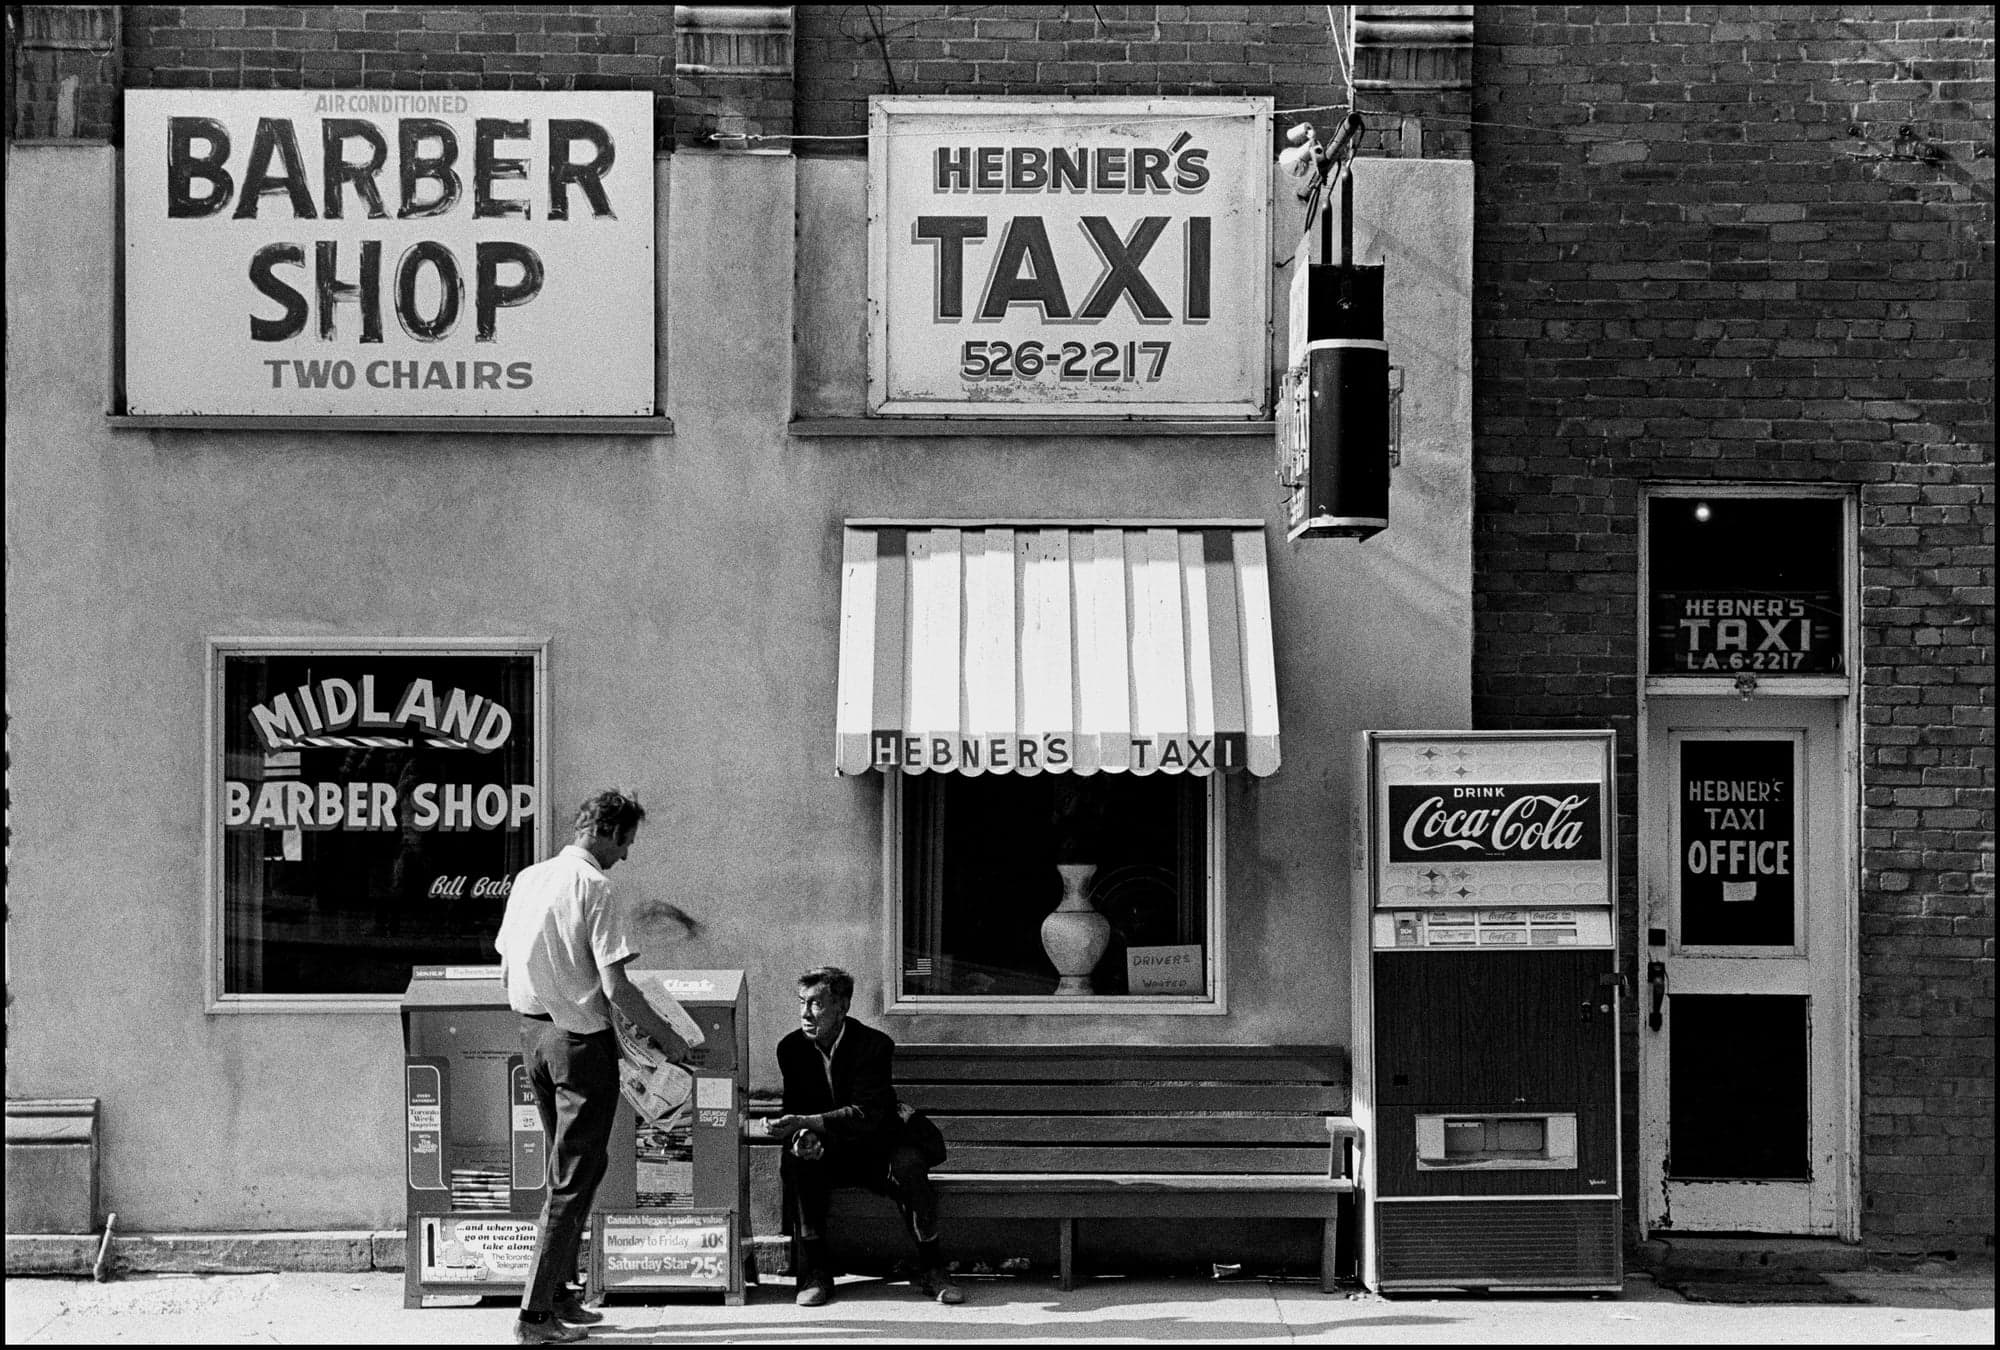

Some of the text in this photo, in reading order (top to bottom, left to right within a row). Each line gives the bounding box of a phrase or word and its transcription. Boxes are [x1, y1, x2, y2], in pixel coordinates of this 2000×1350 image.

[314, 93, 468, 114] AIR CONDITIONED
[167, 115, 617, 221] BARBER
[932, 131, 1211, 194] HEBNER'S
[911, 215, 1212, 325] TAXI
[248, 240, 545, 343] SHOP
[264, 358, 534, 390] TWO CHAIRS
[960, 340, 1172, 382] 526-2217
[1685, 598, 1804, 617] HEBNER'S
[1679, 618, 1812, 652] TAXI
[249, 674, 512, 752] MIDLAND
[875, 732, 1234, 769] HEBNER'S TAXI
[225, 781, 535, 831] BARBER SHOP
[1453, 787, 1505, 798] DRINK
[1689, 778, 1784, 803] HEBNER'S
[1403, 795, 1590, 851] Coca-Cola
[1704, 808, 1765, 831] TAXI
[1688, 840, 1790, 876] OFFICE
[429, 875, 465, 899] Bill
[1133, 954, 1190, 967] DRIVERS
[515, 1225, 534, 1233] you
[608, 1235, 645, 1246] Monday
[648, 1236, 658, 1246] to
[660, 1235, 688, 1247] Friday
[507, 1243, 535, 1251] along
[608, 1256, 724, 1279] Saturday Star 25¢
